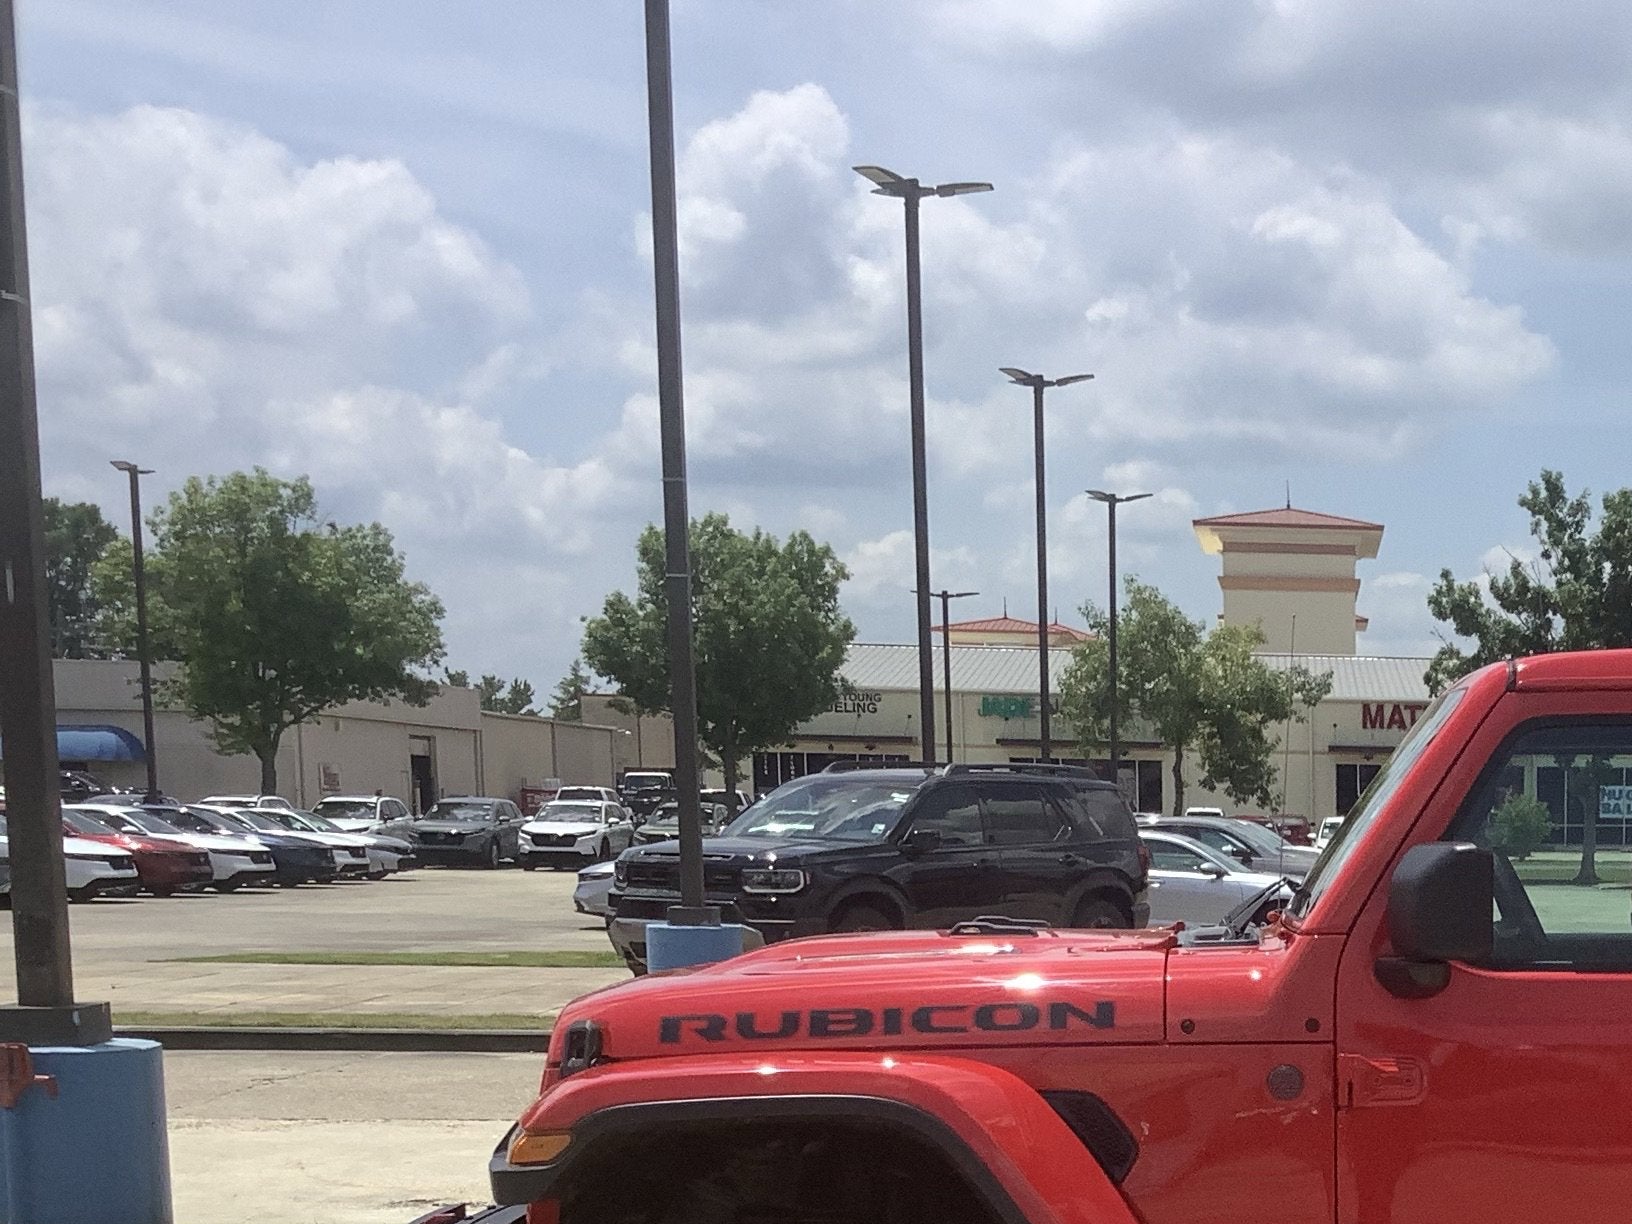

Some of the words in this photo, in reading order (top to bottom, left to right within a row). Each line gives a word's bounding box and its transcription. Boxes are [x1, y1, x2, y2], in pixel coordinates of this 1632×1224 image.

[838, 692, 882, 703] YOUNG
[1362, 703, 1429, 730] MAT
[658, 1000, 1117, 1044] RUBICON
